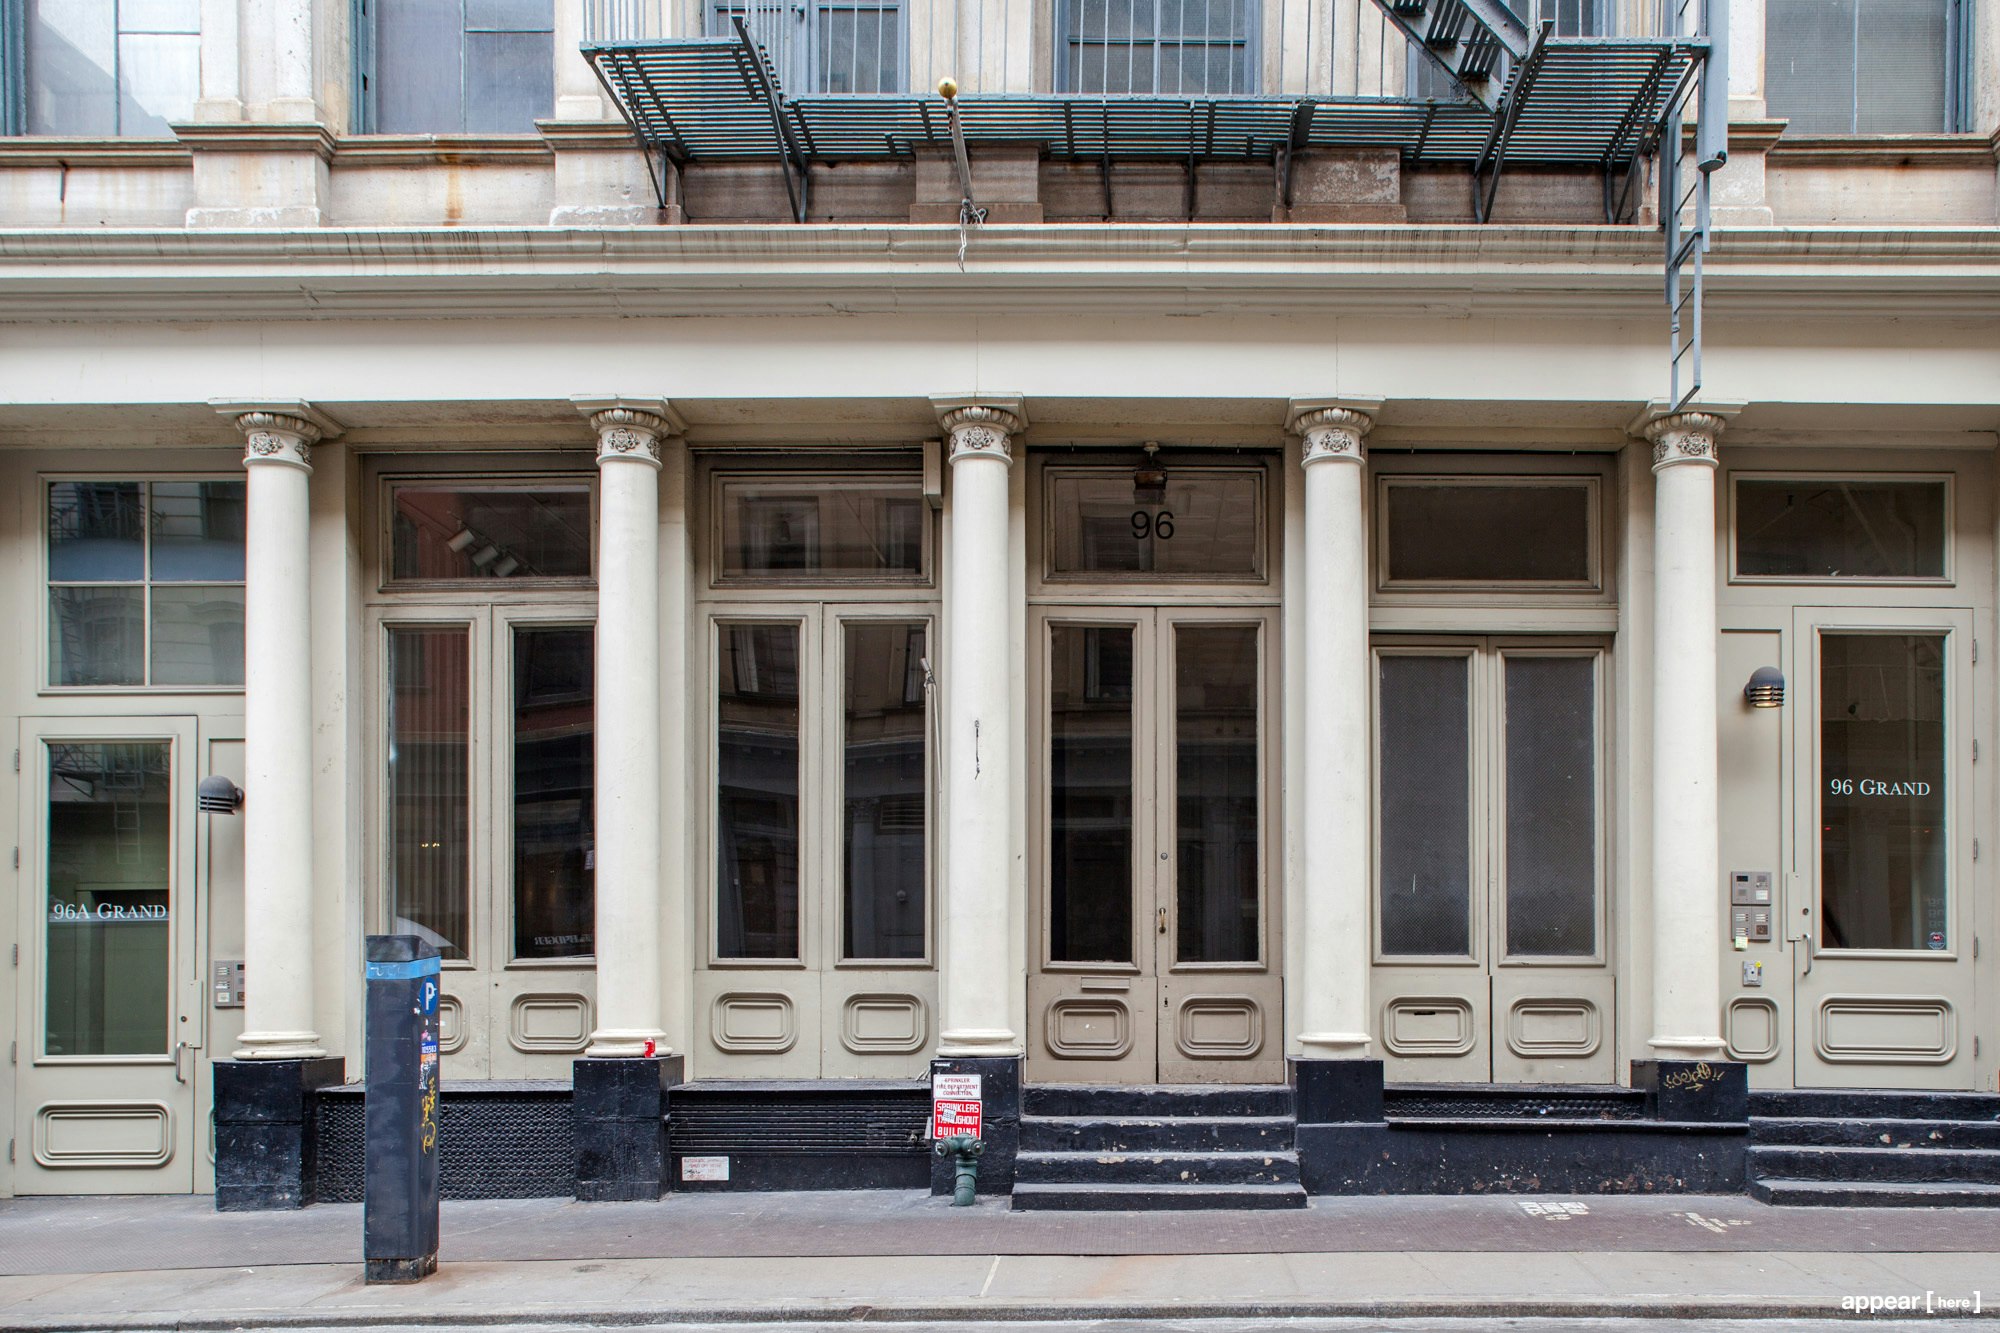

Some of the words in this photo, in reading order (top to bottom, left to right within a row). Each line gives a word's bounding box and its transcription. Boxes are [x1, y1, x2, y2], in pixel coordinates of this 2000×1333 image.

[1131, 510, 1174, 539] 96
[1830, 778, 1853, 795] 96
[1859, 778, 1930, 796] GRAND
[53, 904, 90, 919] 96A
[97, 902, 166, 919] GRAND
[937, 1103, 979, 1113] SPRINKLERS
[937, 1115, 979, 1125] TUGHOUT
[938, 1127, 977, 1136] BUILDING
